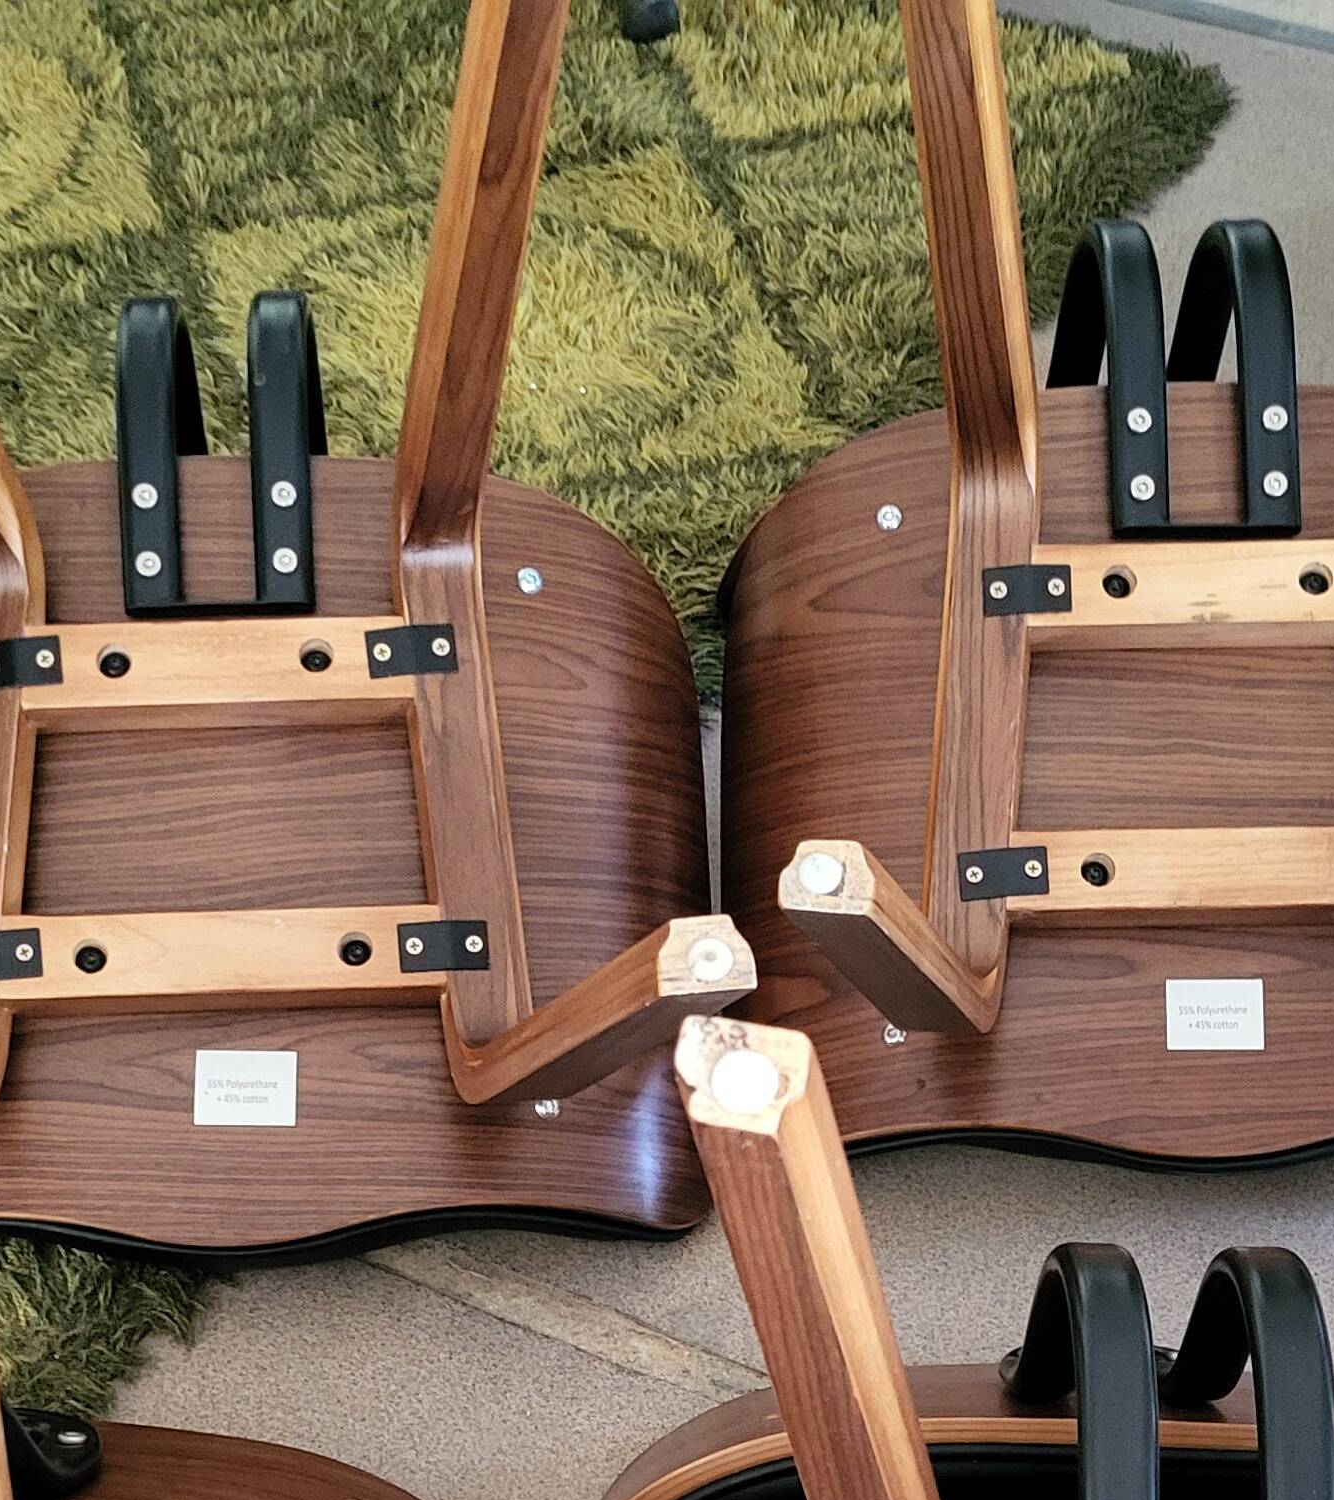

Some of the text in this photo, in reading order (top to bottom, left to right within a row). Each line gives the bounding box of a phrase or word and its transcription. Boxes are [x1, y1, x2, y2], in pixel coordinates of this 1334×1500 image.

[1178, 1005, 1248, 1016] 55% Polyurethane
[1213, 1021, 1239, 1030] cotton
